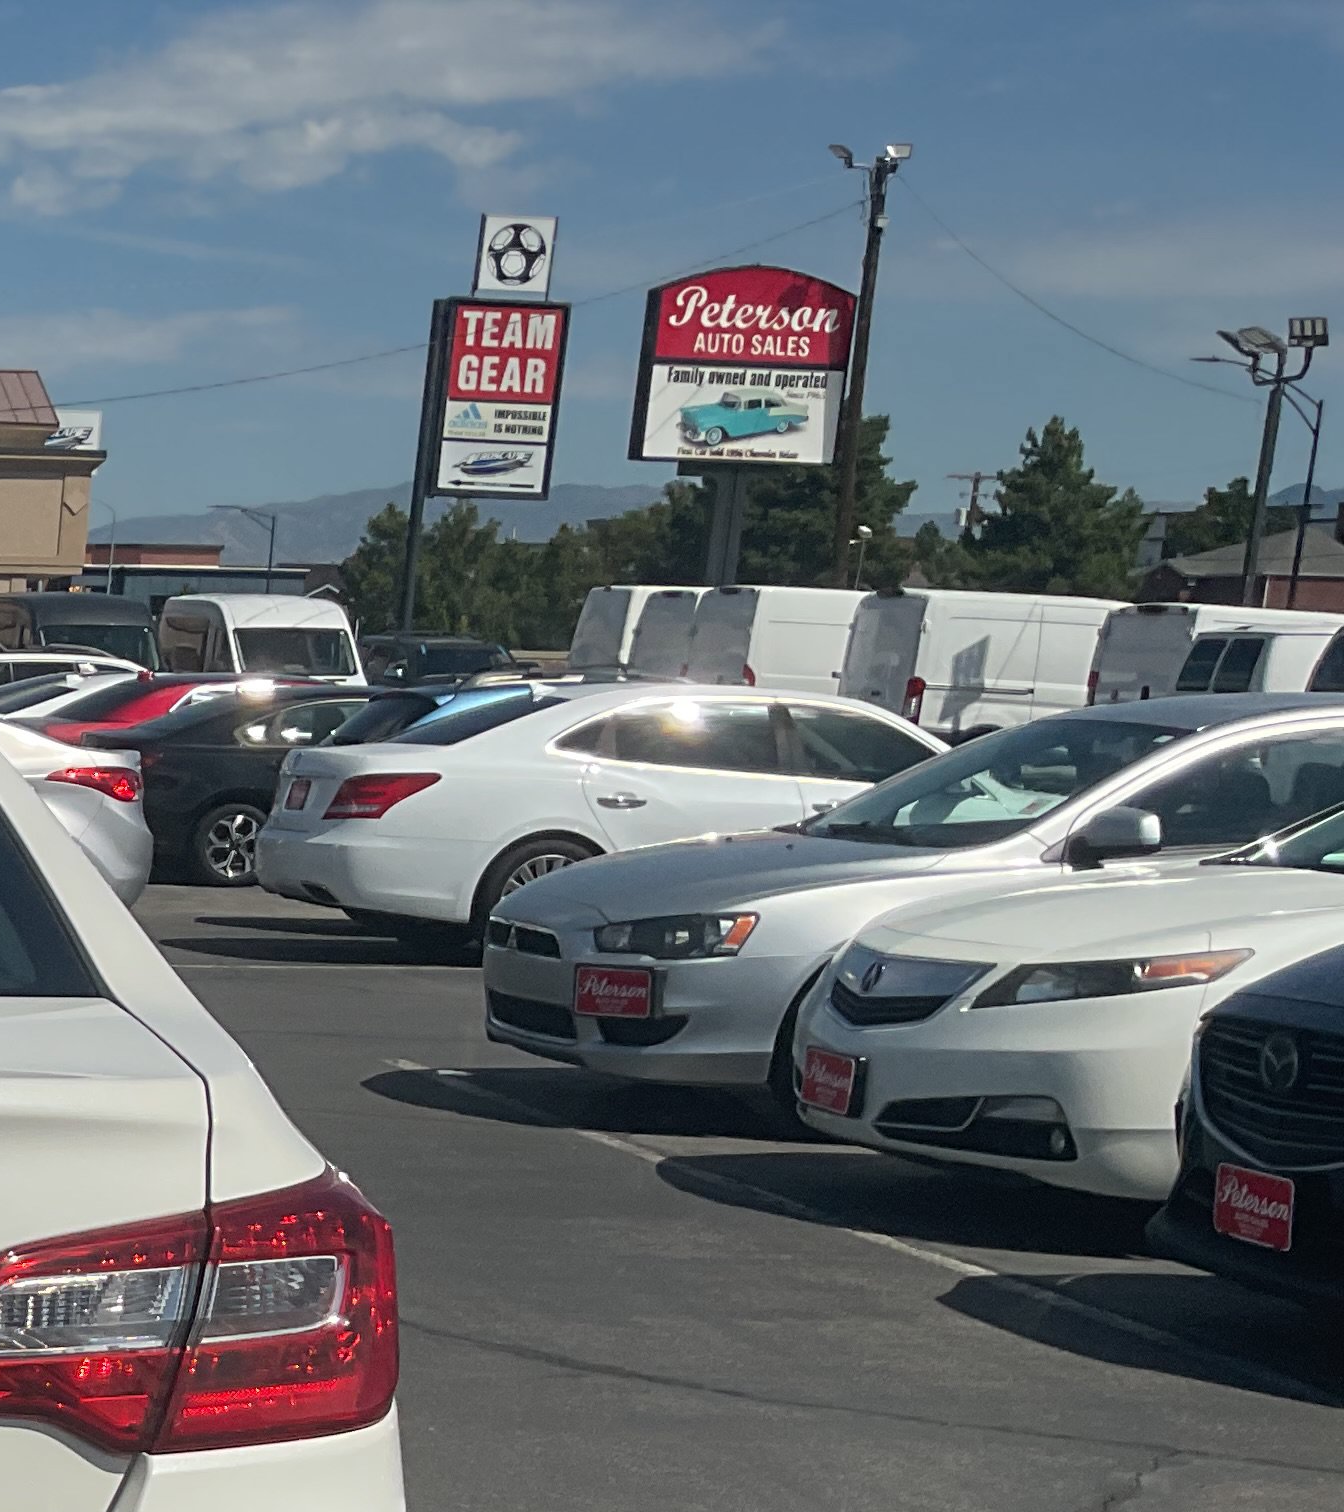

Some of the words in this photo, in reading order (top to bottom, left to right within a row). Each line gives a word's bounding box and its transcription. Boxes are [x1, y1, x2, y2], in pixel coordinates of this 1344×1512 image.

[668, 286, 841, 333] Peterson
[463, 311, 556, 349] TEAM
[694, 332, 744, 354] AUTO
[751, 333, 810, 357] SALES
[458, 354, 546, 394] GEAR
[668, 366, 703, 386] Family
[709, 369, 746, 385] owned
[750, 371, 771, 387] and
[775, 372, 828, 390] operated
[493, 423, 503, 433] IS
[505, 424, 544, 436] NOTHING
[494, 409, 546, 421] IMPOSSIBLE
[1217, 1175, 1289, 1221] Peterson
